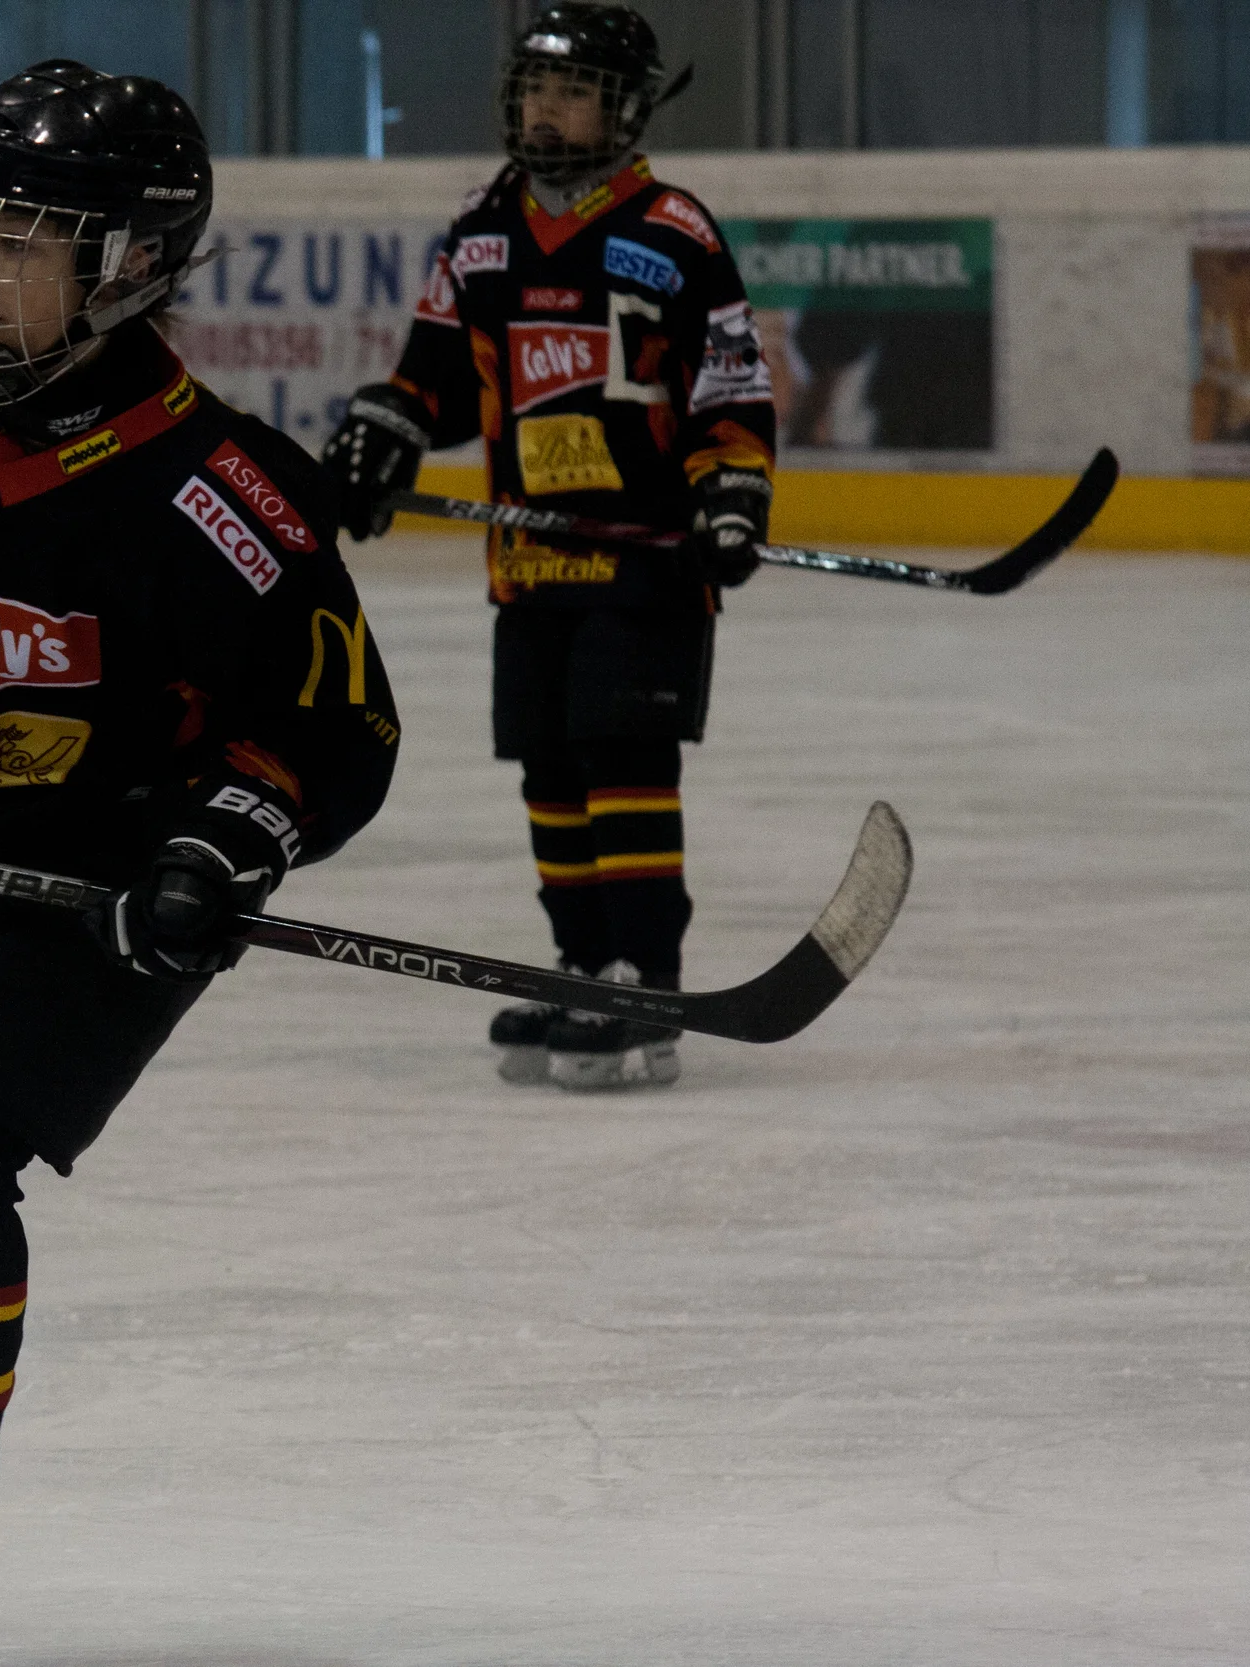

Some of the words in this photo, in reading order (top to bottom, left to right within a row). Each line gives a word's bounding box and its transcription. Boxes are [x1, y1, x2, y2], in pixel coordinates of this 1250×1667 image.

[216, 455, 287, 518] ASKÖ
[181, 484, 278, 588] RICOH
[311, 930, 467, 986] VAPOR
